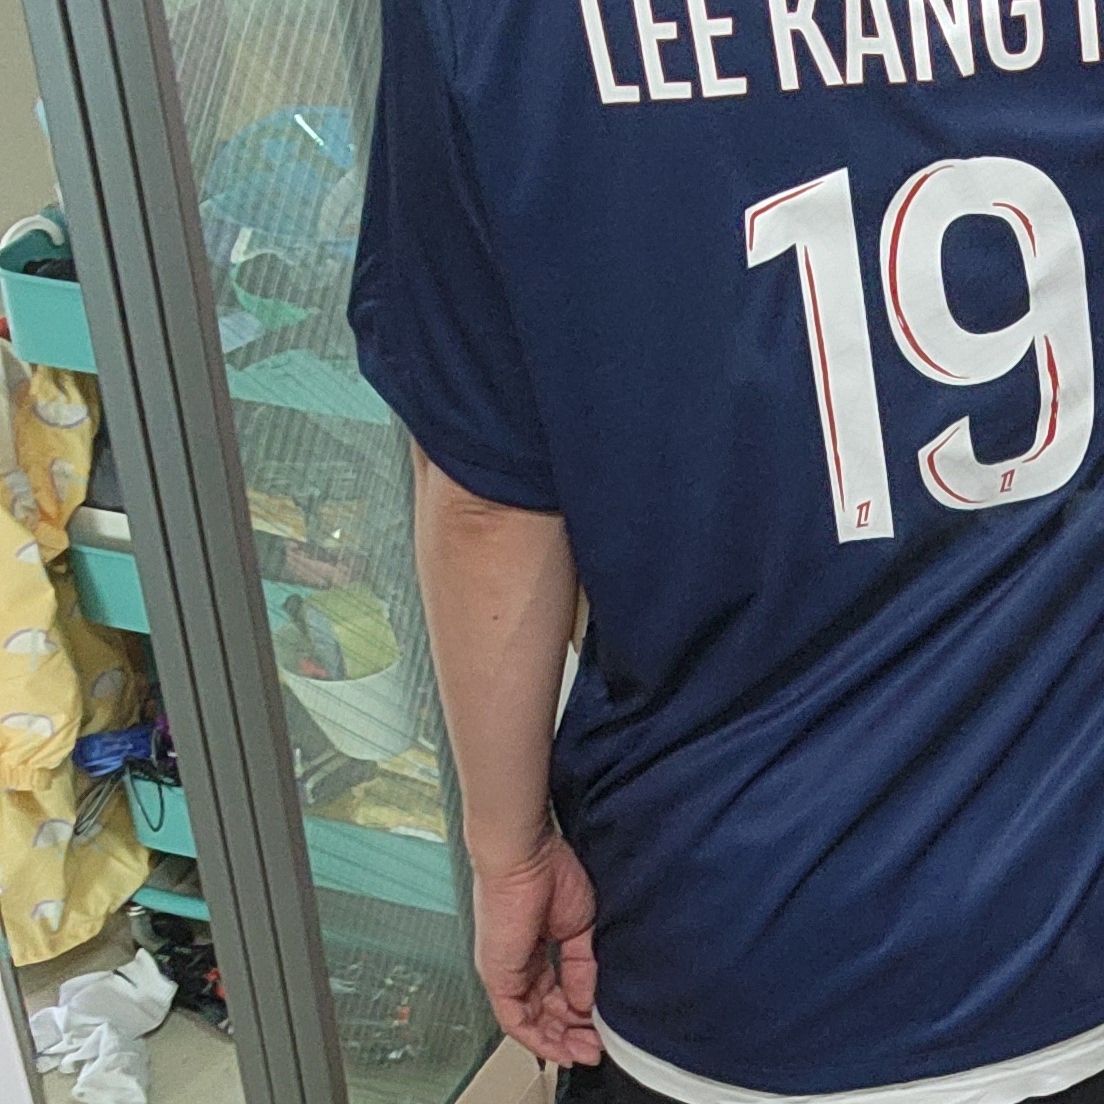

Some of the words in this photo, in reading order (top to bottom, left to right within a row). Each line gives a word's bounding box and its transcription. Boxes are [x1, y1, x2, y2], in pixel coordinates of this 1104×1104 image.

[580, 0, 747, 104] LEE
[767, 0, 1043, 91] KANG
[744, 156, 1095, 544] 19
